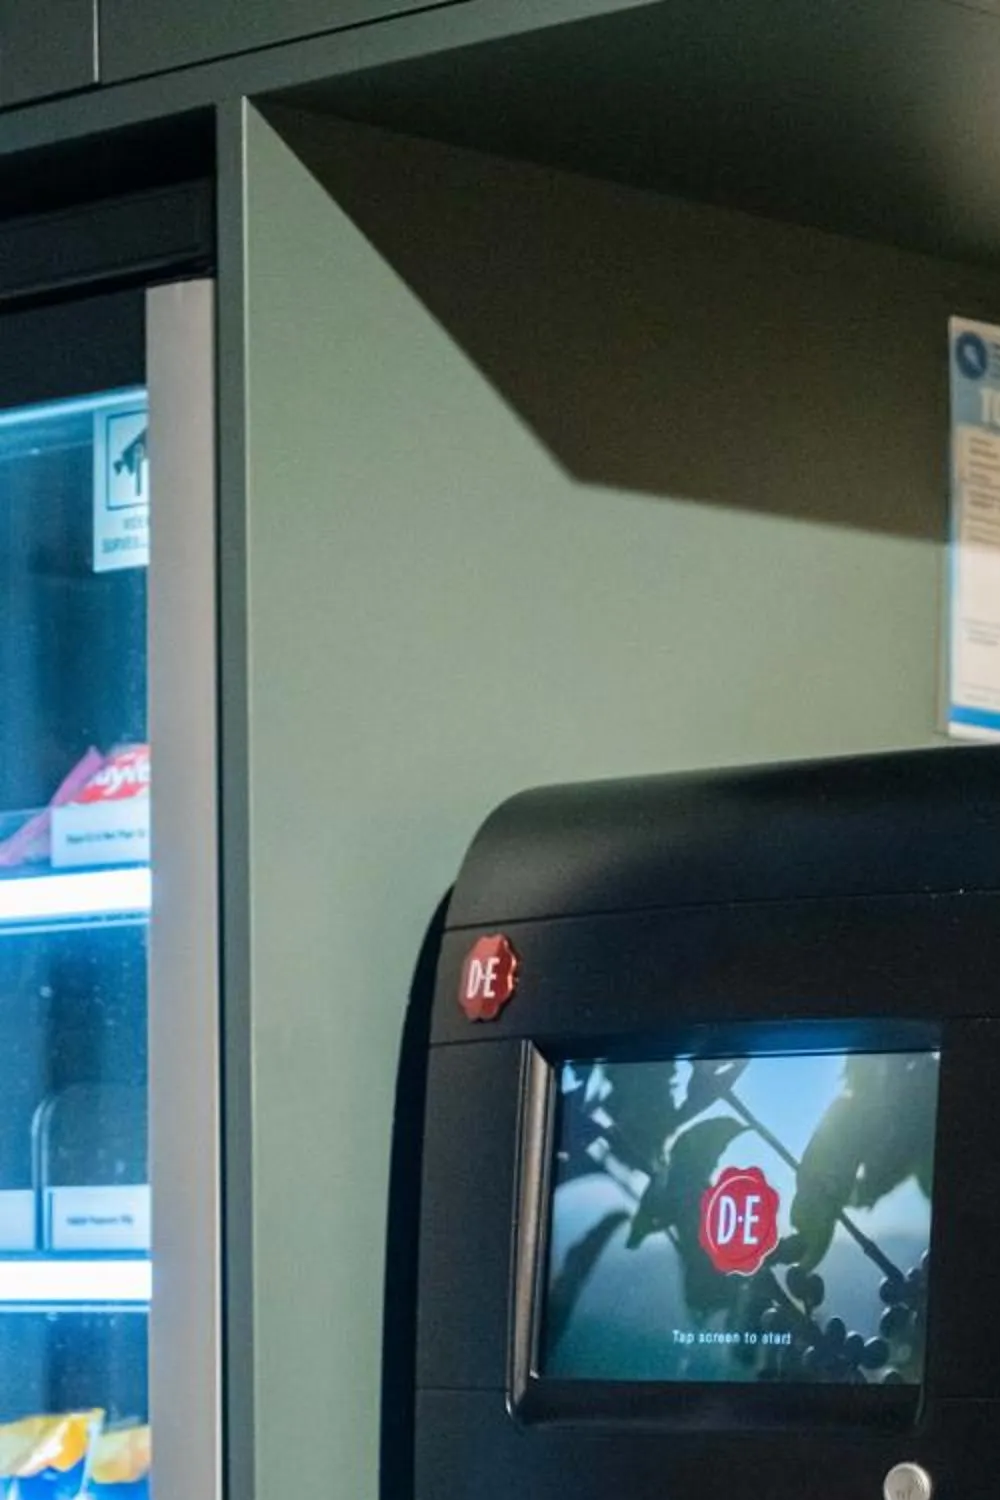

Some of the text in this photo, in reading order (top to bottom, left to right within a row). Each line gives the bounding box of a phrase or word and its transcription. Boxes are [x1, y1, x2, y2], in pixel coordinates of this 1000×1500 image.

[672, 1329, 791, 1345] Tap screen to start
